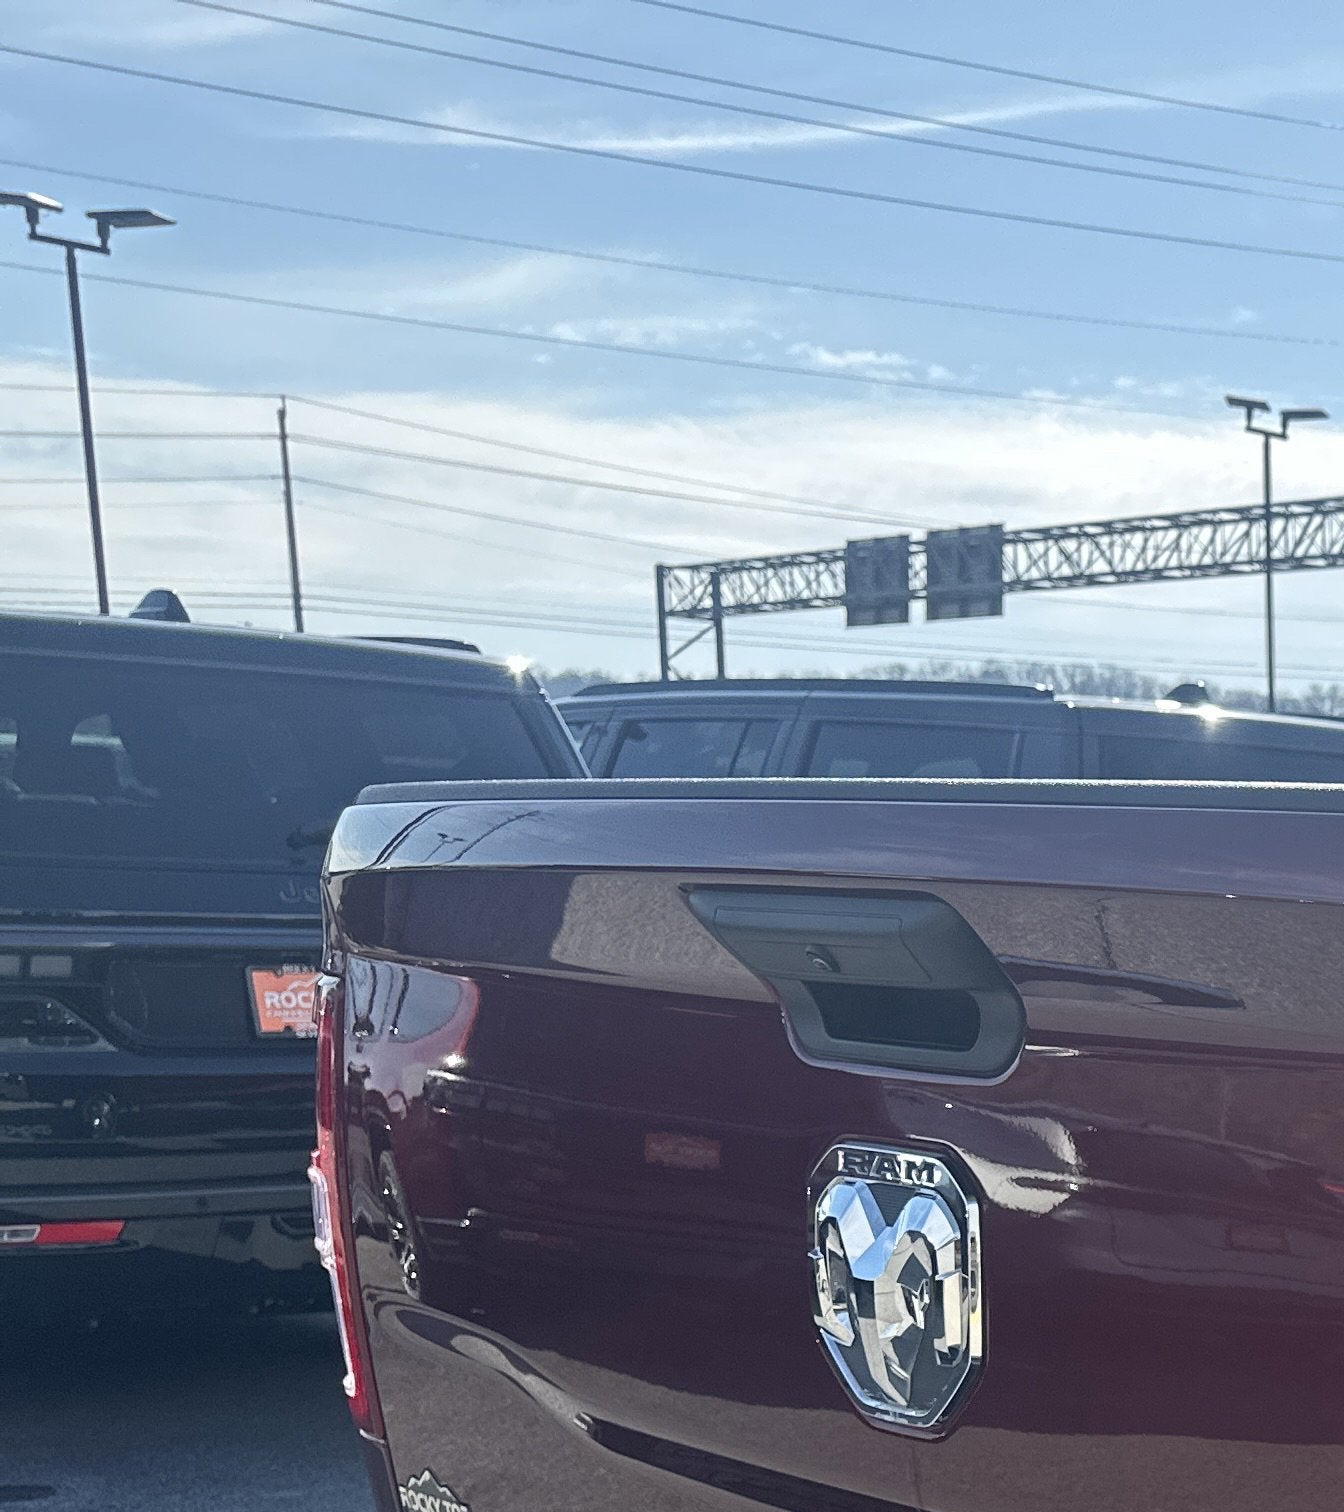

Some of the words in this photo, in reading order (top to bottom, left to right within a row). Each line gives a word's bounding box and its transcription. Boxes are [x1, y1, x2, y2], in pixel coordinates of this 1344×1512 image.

[279, 879, 320, 904] Je
[264, 990, 314, 1009] ROC
[837, 1151, 941, 1187] RAM
